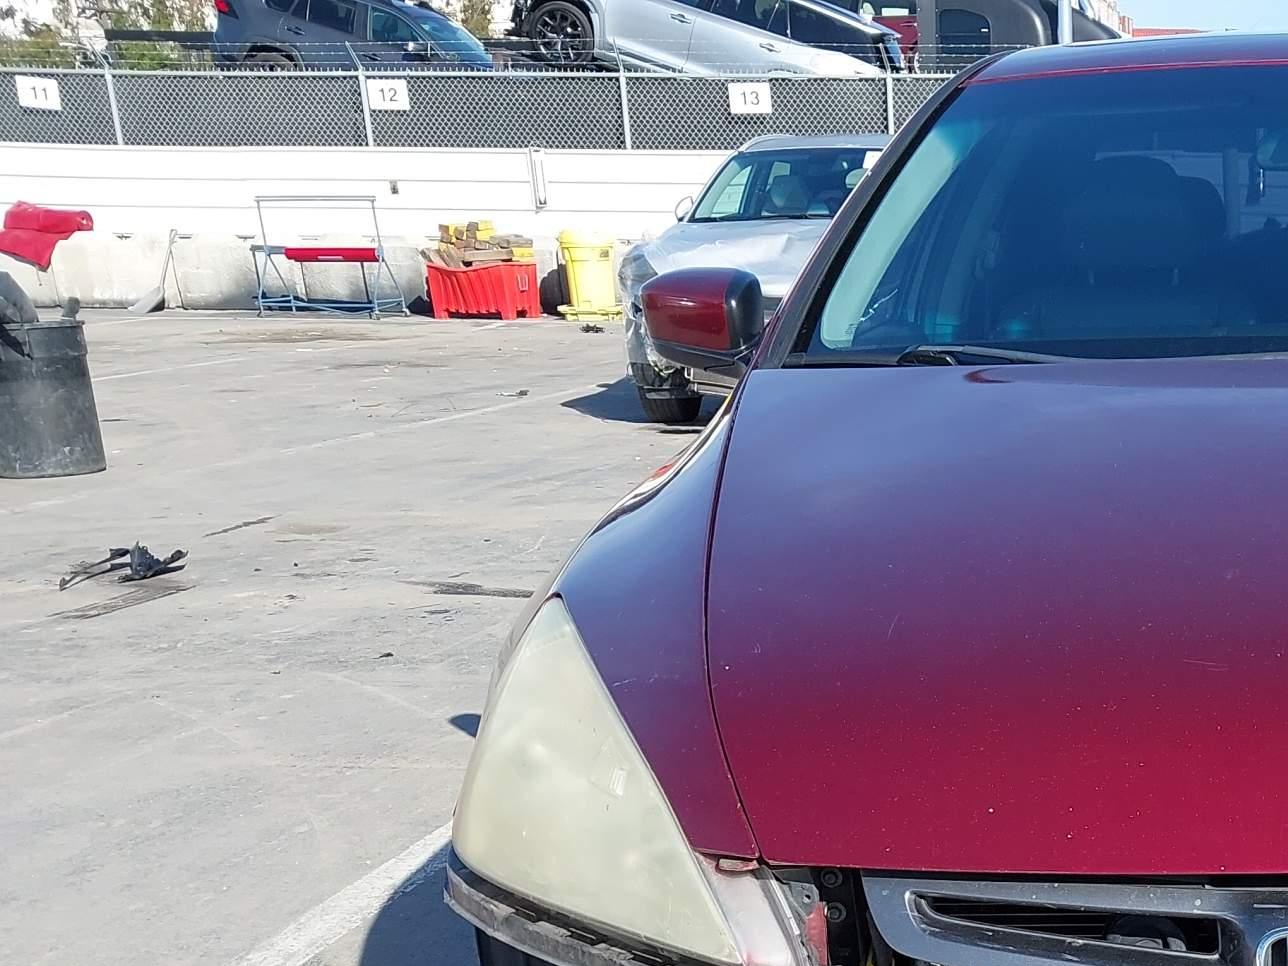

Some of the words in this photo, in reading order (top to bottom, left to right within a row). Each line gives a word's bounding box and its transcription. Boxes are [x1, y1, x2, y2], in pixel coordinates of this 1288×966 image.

[30, 86, 48, 101] 11
[379, 87, 399, 102] 12
[740, 90, 760, 106] 13
